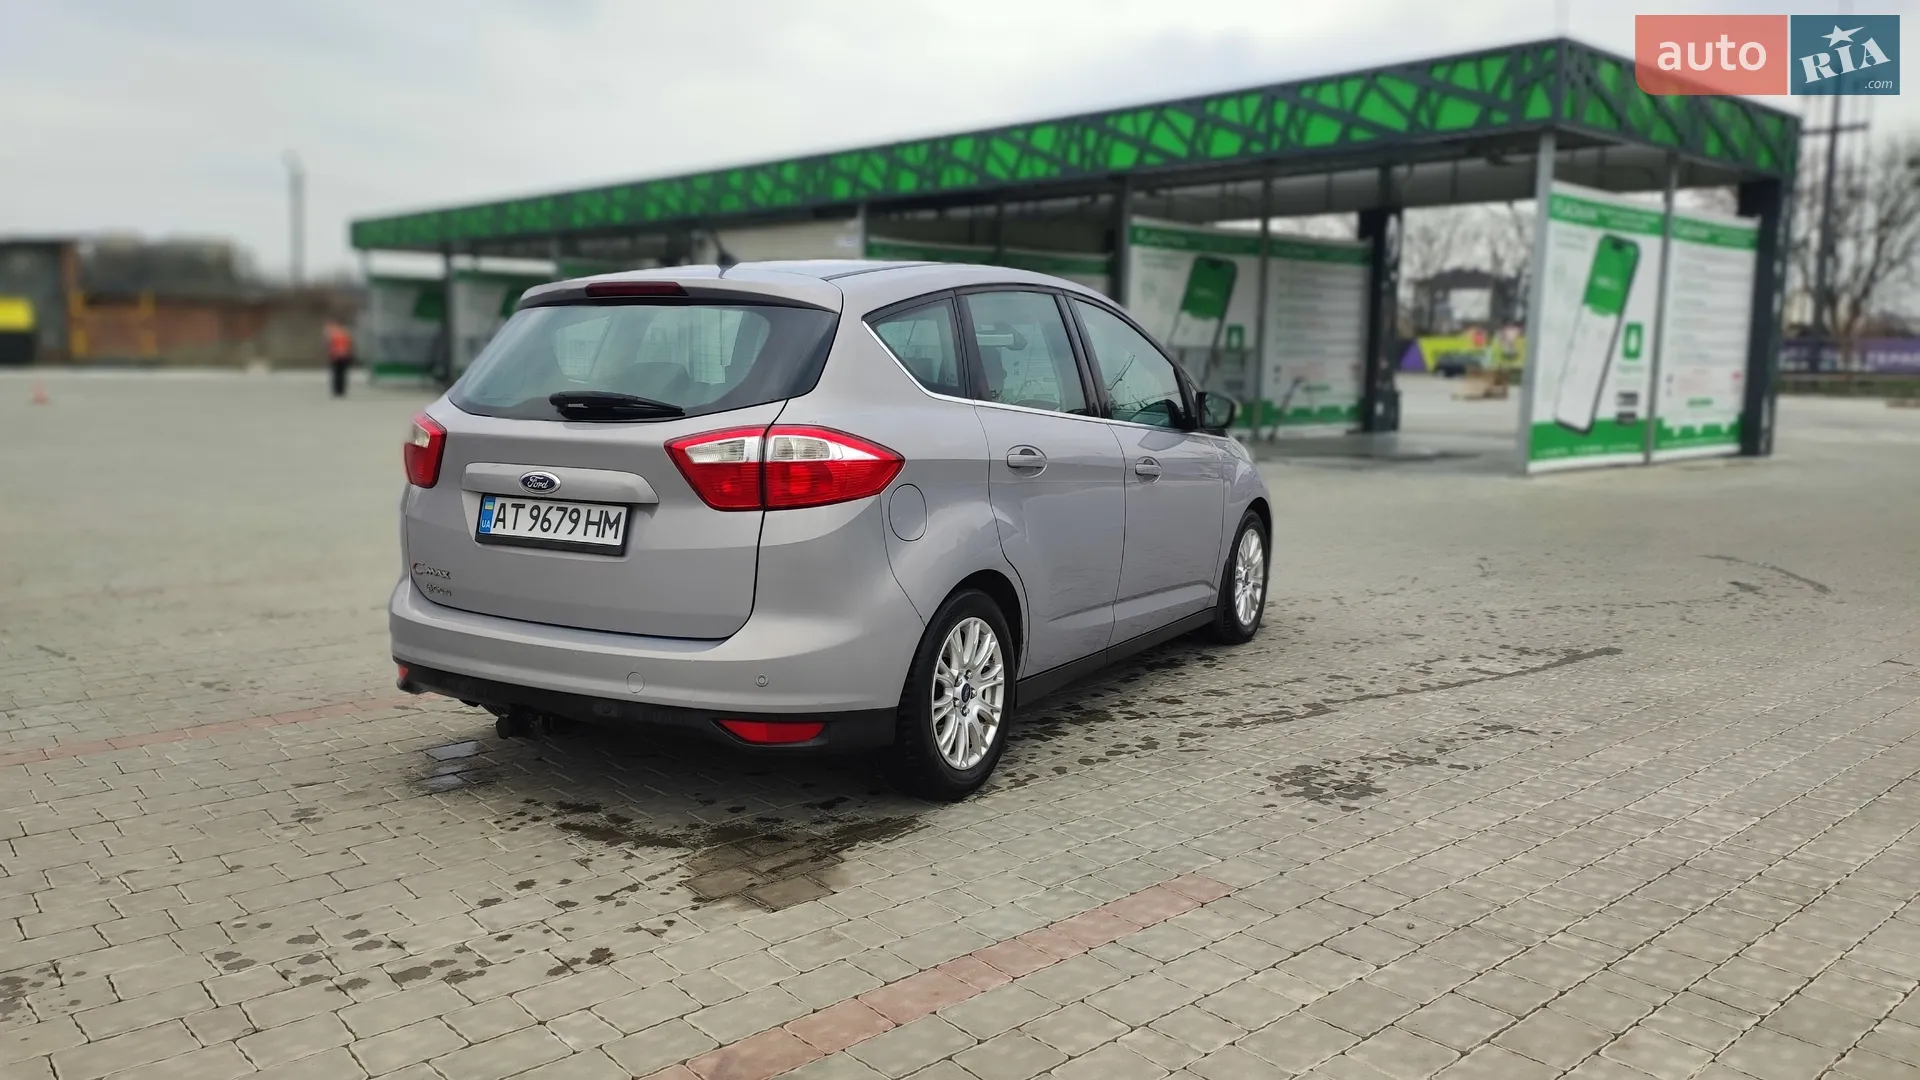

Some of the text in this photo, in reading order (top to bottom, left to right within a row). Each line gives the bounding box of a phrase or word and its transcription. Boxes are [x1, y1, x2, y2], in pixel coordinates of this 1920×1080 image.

[527, 475, 549, 489] Ford
[481, 519, 491, 529] UA
[493, 503, 622, 539] AT 9679 HM
